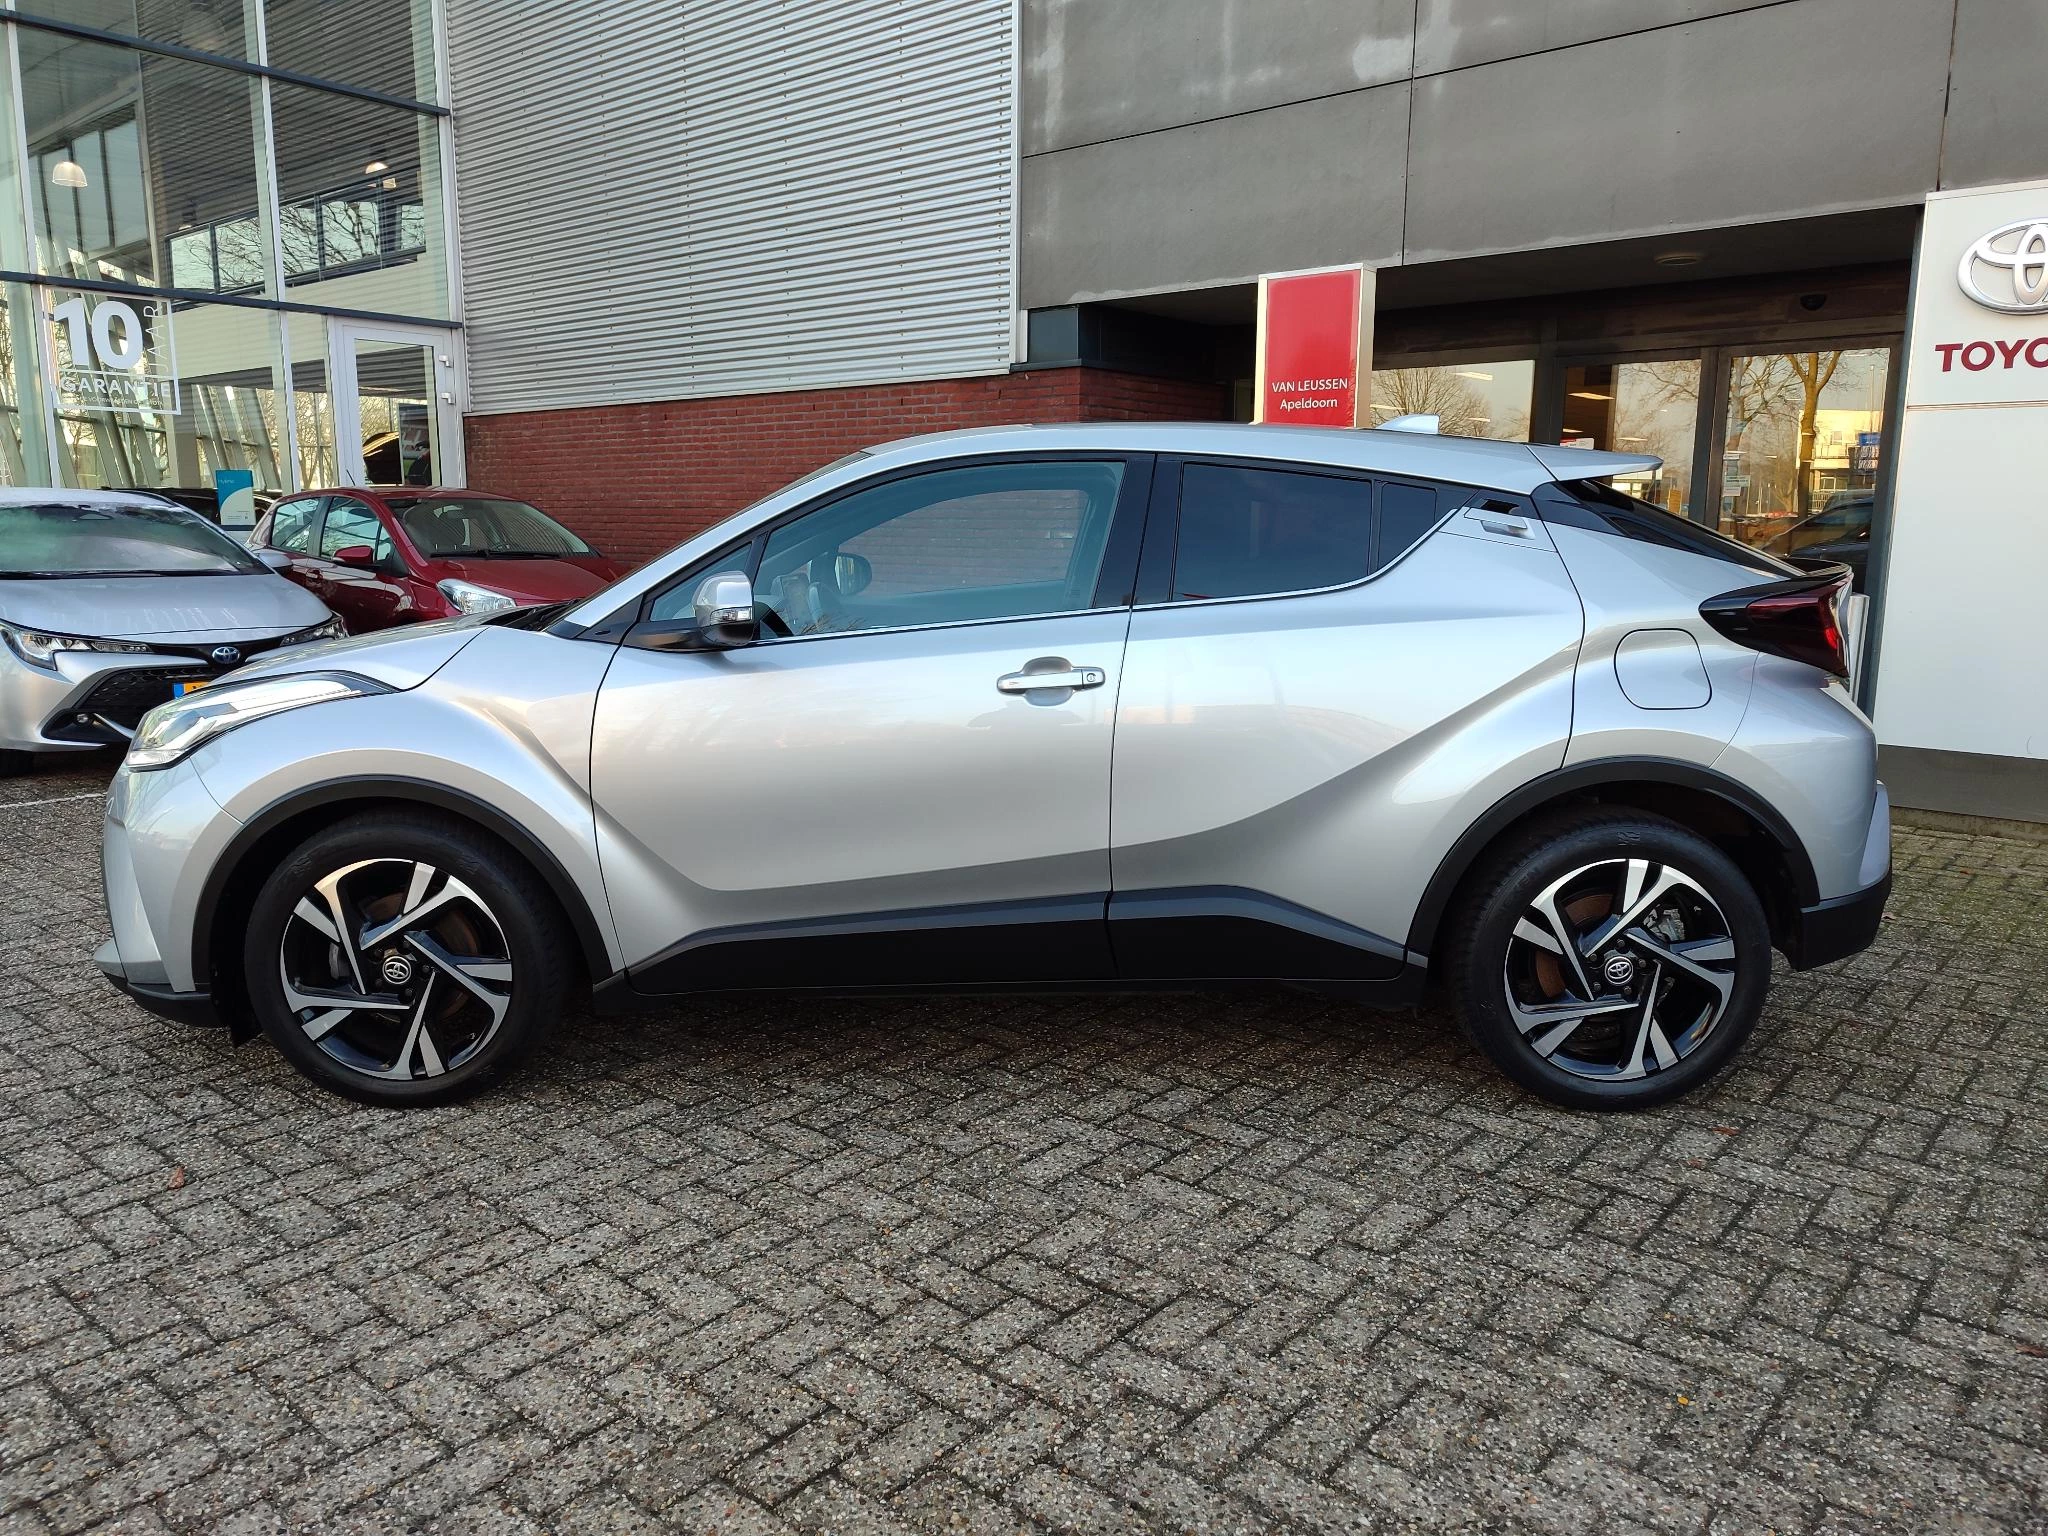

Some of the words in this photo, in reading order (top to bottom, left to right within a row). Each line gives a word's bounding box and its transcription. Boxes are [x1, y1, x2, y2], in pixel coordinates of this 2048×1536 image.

[53, 297, 143, 370] 10
[143, 305, 169, 372] JAAR
[1272, 381, 1295, 393] VAN
[1297, 378, 1348, 392] LEUSSEN
[1280, 397, 1338, 412] Apeldoorn
